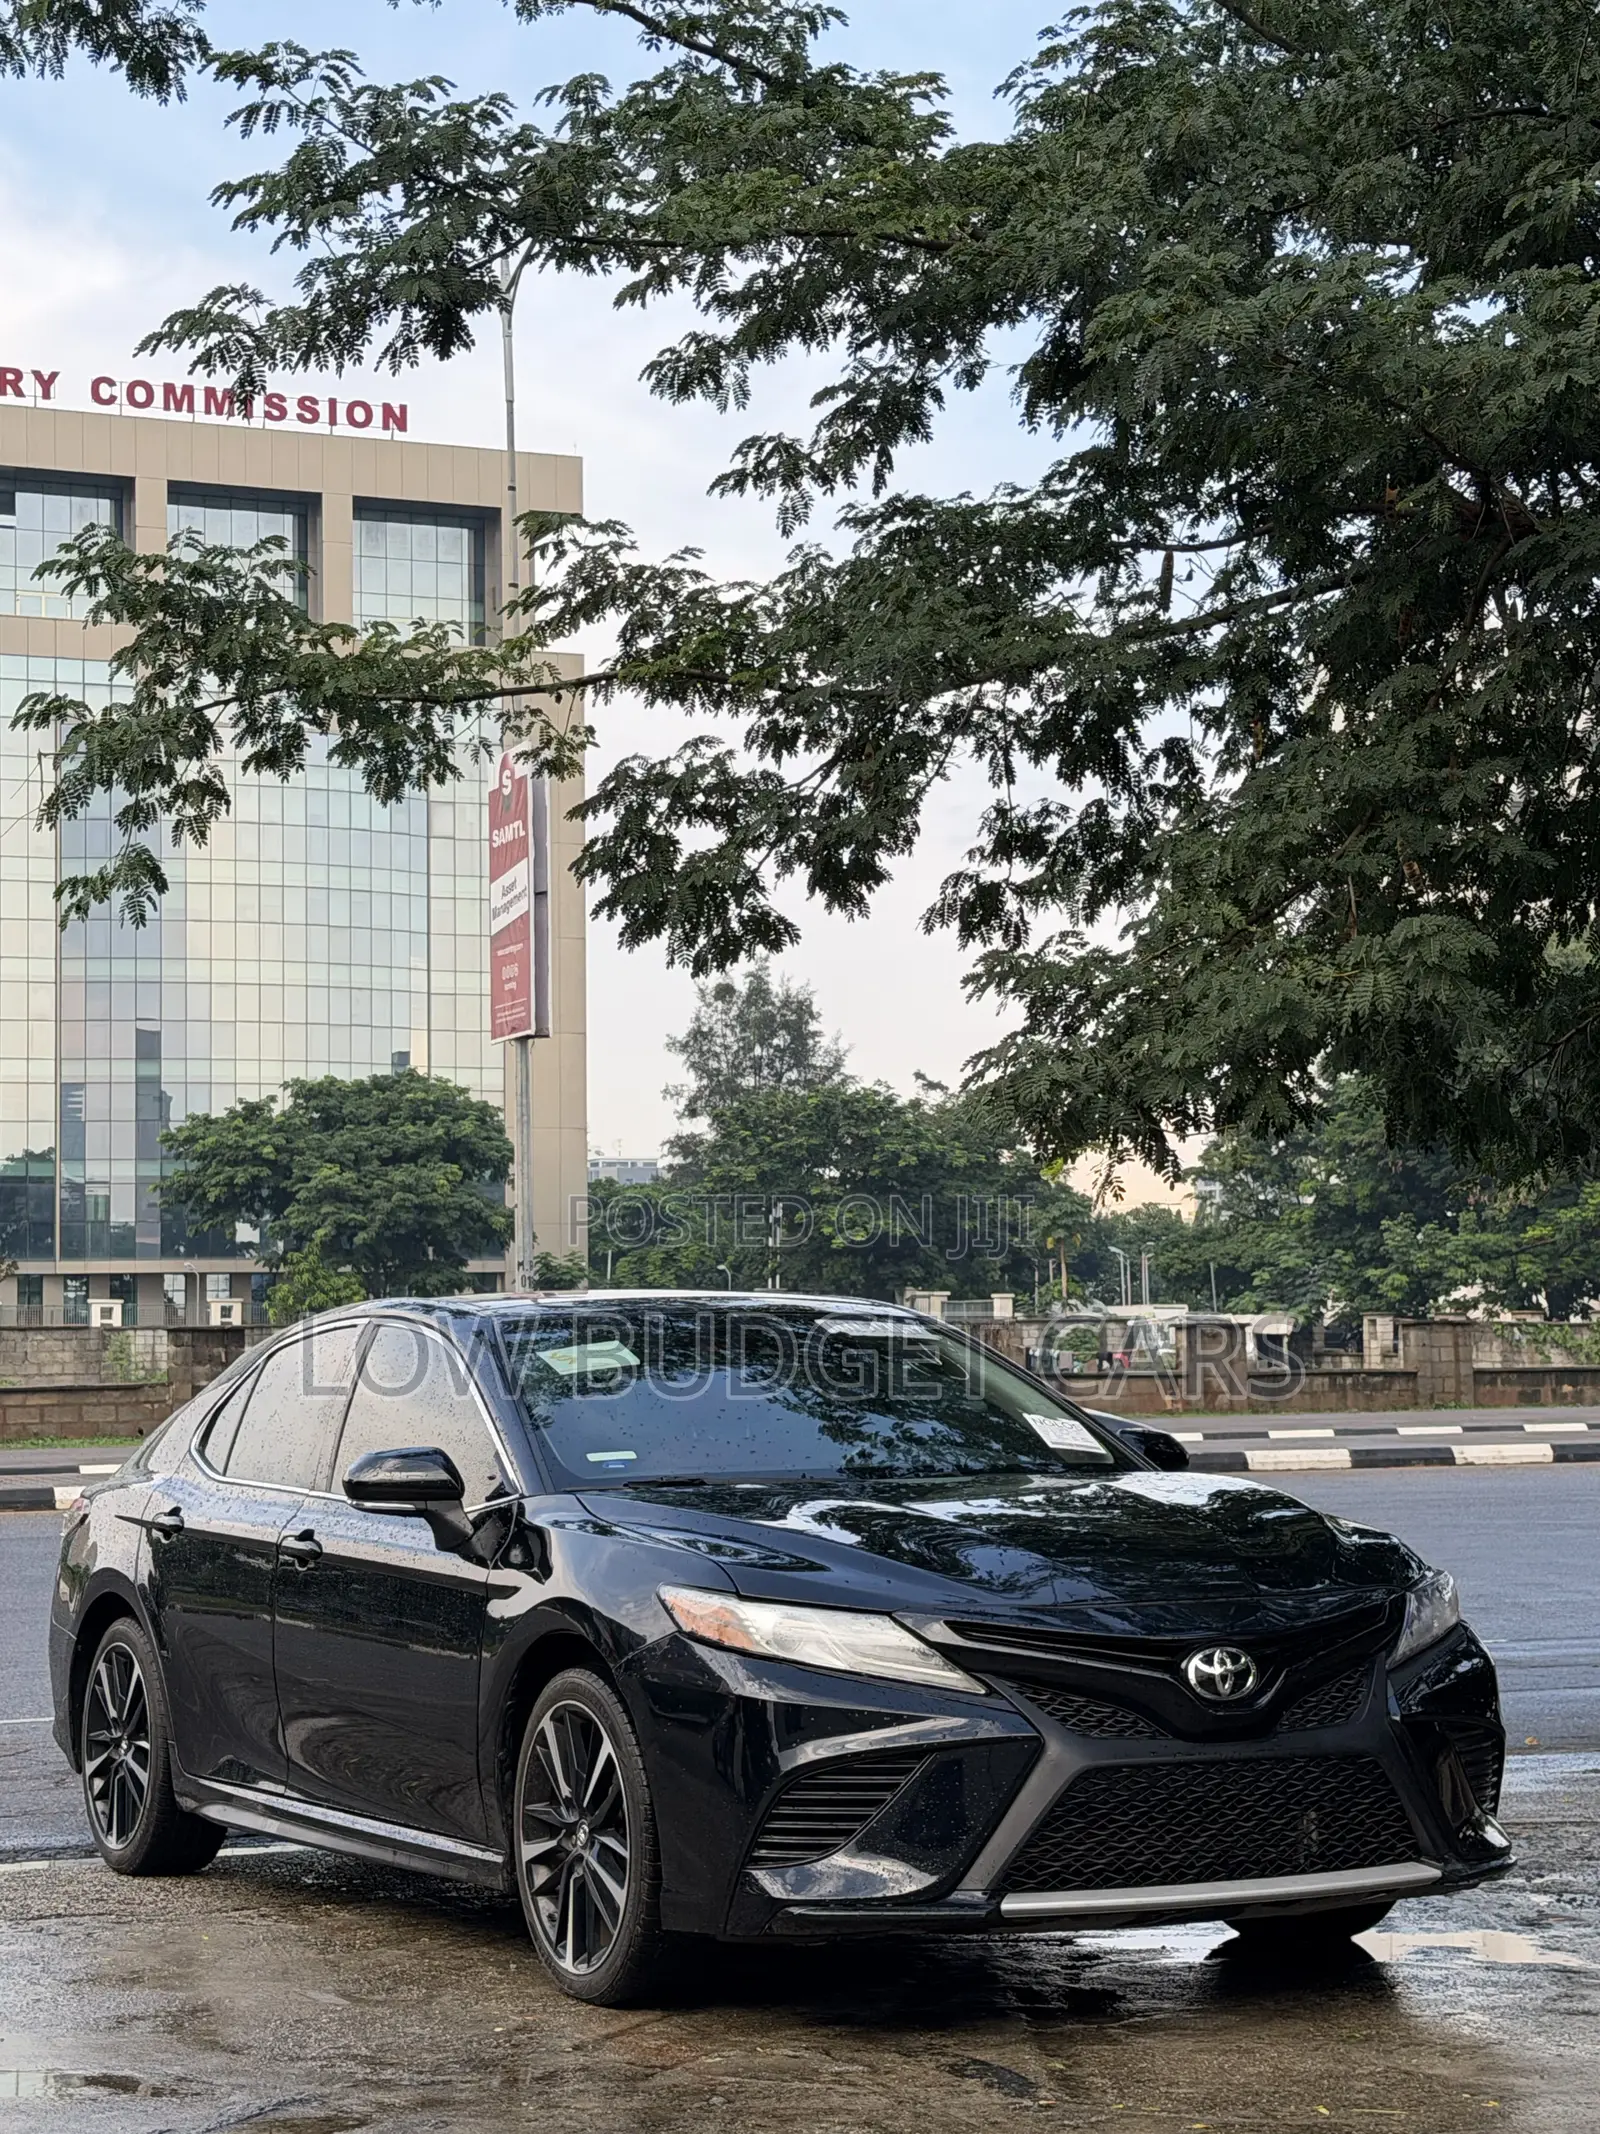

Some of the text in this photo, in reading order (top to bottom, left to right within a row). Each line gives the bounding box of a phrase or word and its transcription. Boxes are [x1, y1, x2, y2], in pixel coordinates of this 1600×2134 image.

[0, 366, 61, 400] RY
[492, 819, 526, 848] SAMTL
[501, 876, 517, 899] Asset
